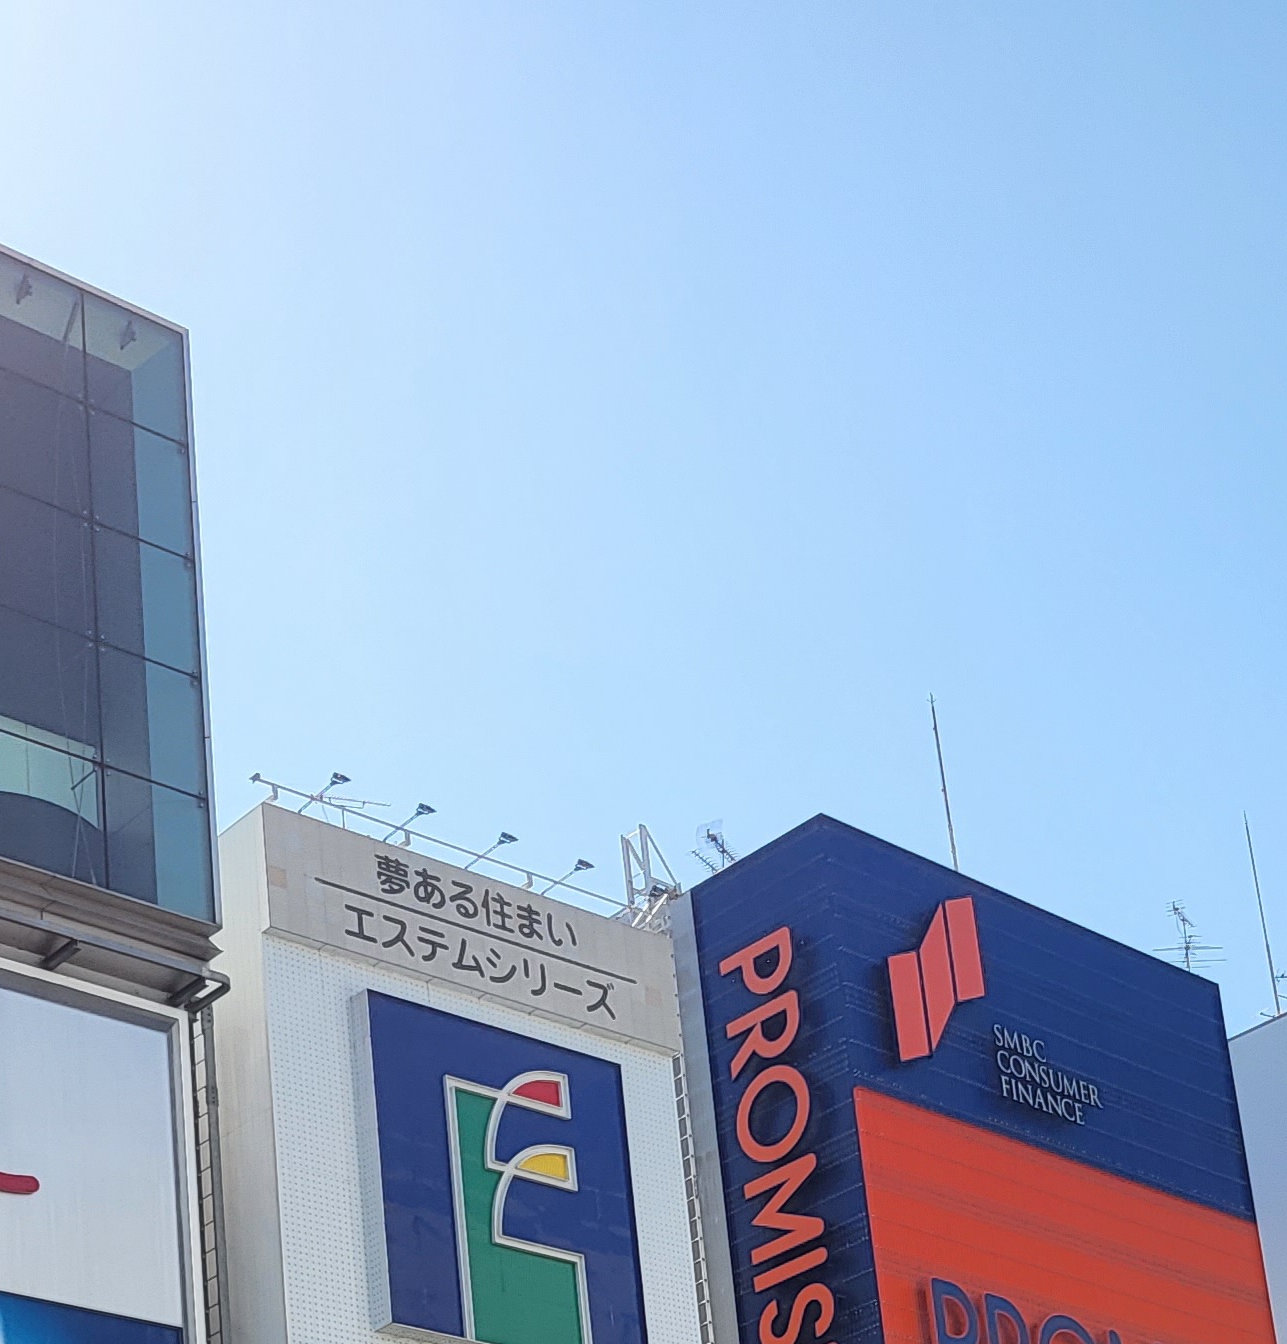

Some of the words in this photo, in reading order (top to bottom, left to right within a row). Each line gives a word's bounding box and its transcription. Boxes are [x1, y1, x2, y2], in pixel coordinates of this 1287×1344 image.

[374, 852, 579, 950] 夢ある住まい
[344, 904, 618, 1021] エステムシリーズ
[992, 1022, 1047, 1066] SMBC
[996, 1050, 1103, 1109] CONSUMER
[1000, 1075, 1086, 1127] FINANCE
